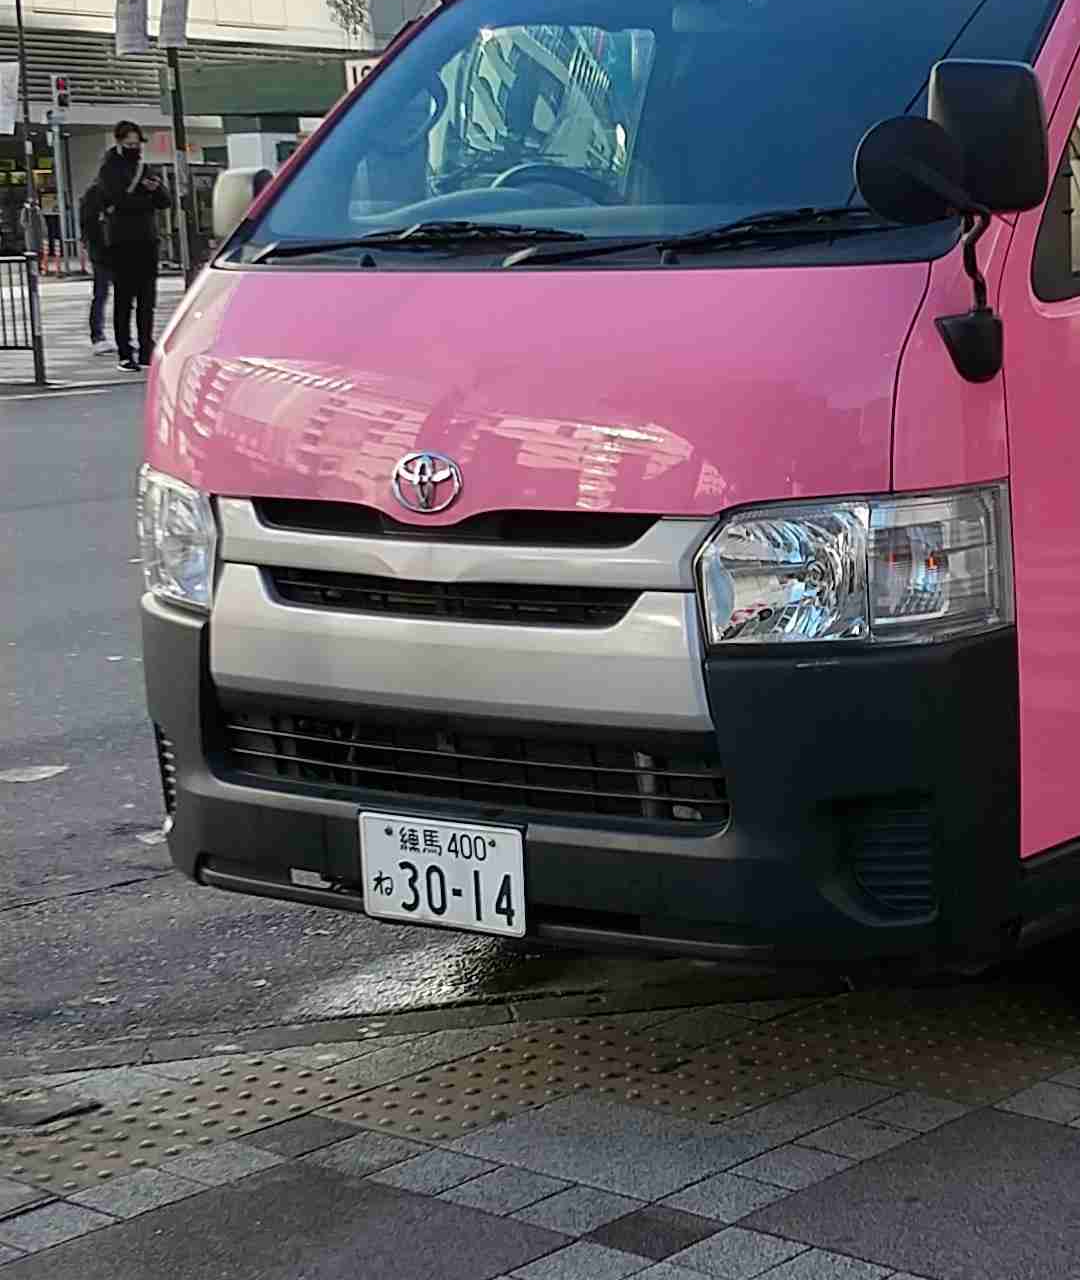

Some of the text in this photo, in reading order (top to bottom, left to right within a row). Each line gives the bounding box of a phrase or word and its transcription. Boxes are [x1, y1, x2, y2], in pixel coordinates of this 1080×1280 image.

[399, 826, 488, 862] 練馬 400
[373, 860, 516, 927] ね 30-14
